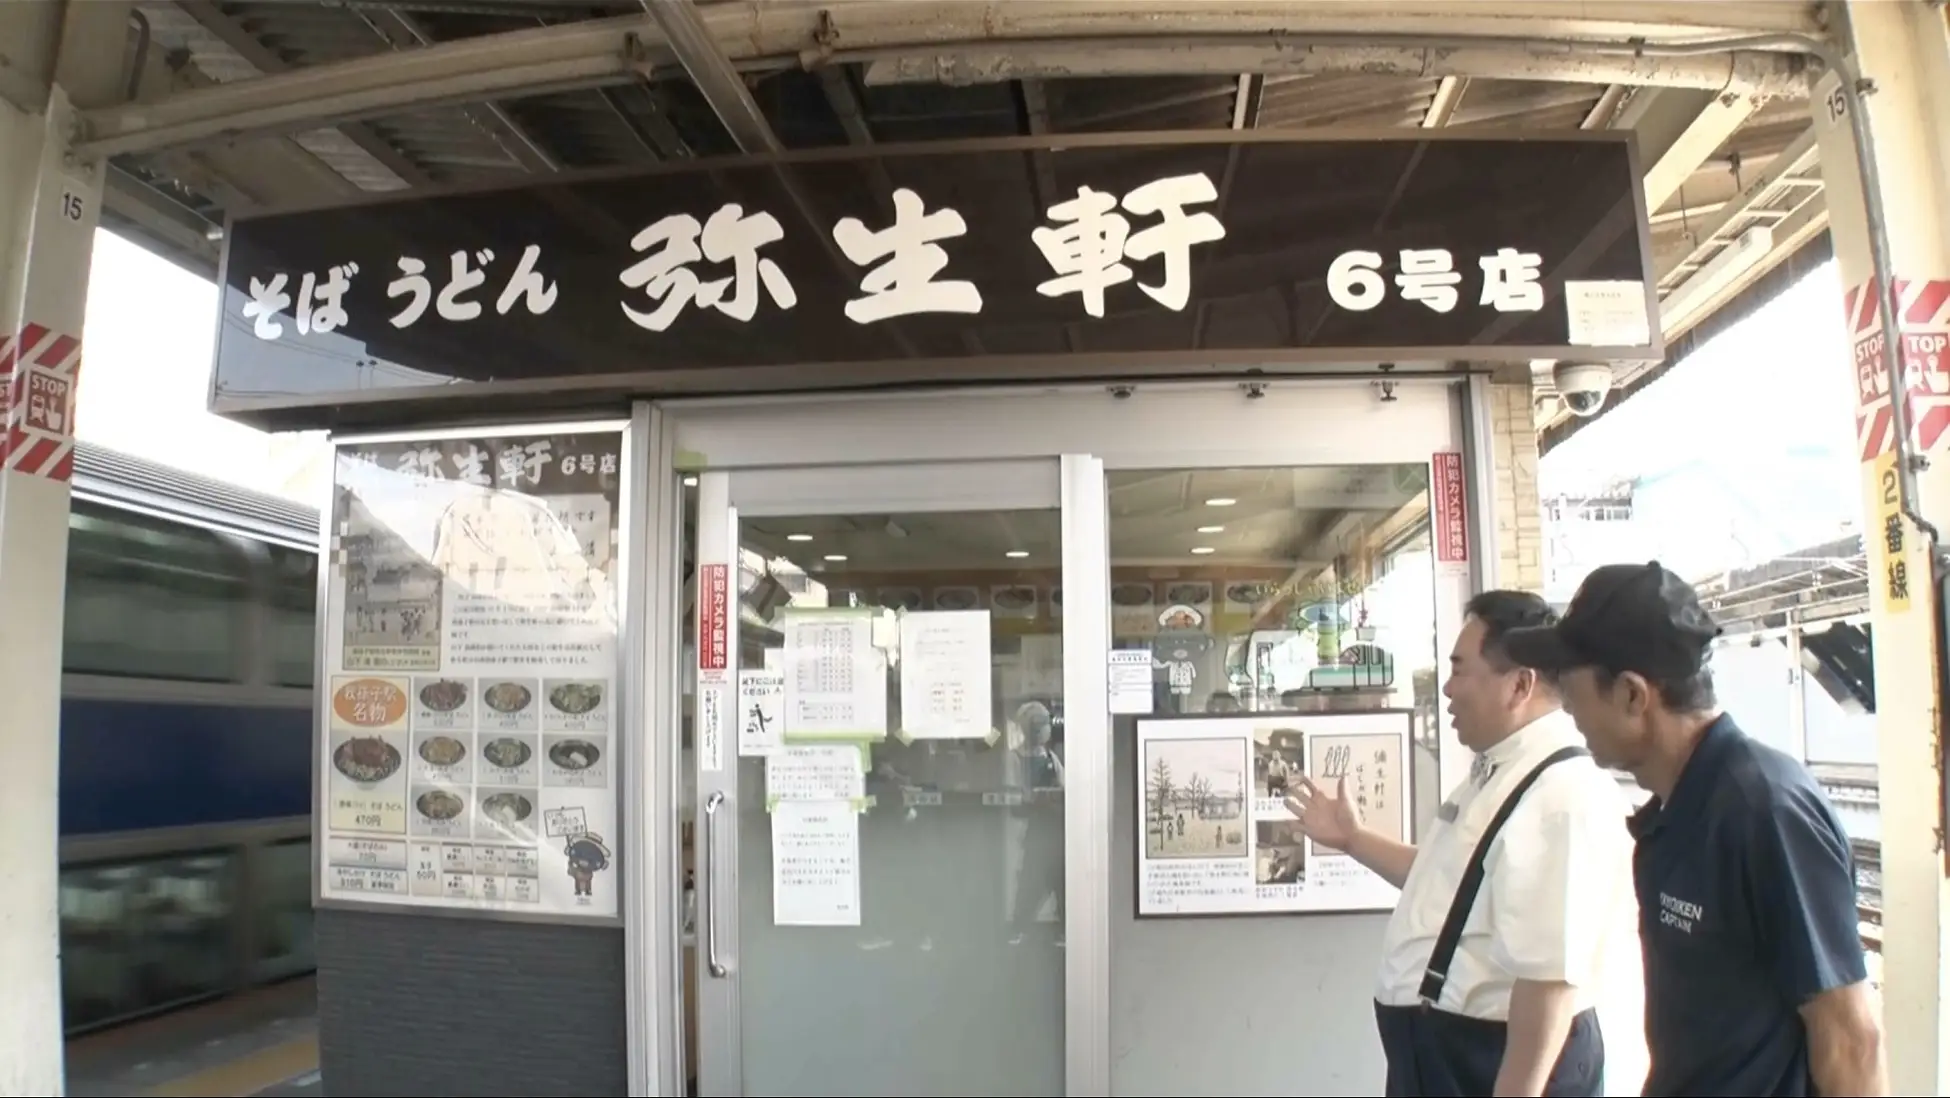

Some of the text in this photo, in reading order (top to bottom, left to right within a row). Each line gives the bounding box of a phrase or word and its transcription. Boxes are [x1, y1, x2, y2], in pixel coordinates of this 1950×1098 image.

[1827, 87, 1846, 122] 15
[62, 193, 82, 221] 15
[242, 172, 1545, 340] そば うどん 弥生軒 6号店
[1907, 335, 1947, 354] TOP
[31, 374, 66, 398] STOP
[398, 441, 551, 486] 弥生軒
[561, 454, 616, 476] 6号店
[1446, 454, 1465, 559] 防犯カメラ監視中
[1882, 470, 1909, 600] 2番線
[713, 566, 726, 666] 防犯カメラ監視中
[353, 702, 386, 722] 名物
[356, 814, 382, 827] 470円
